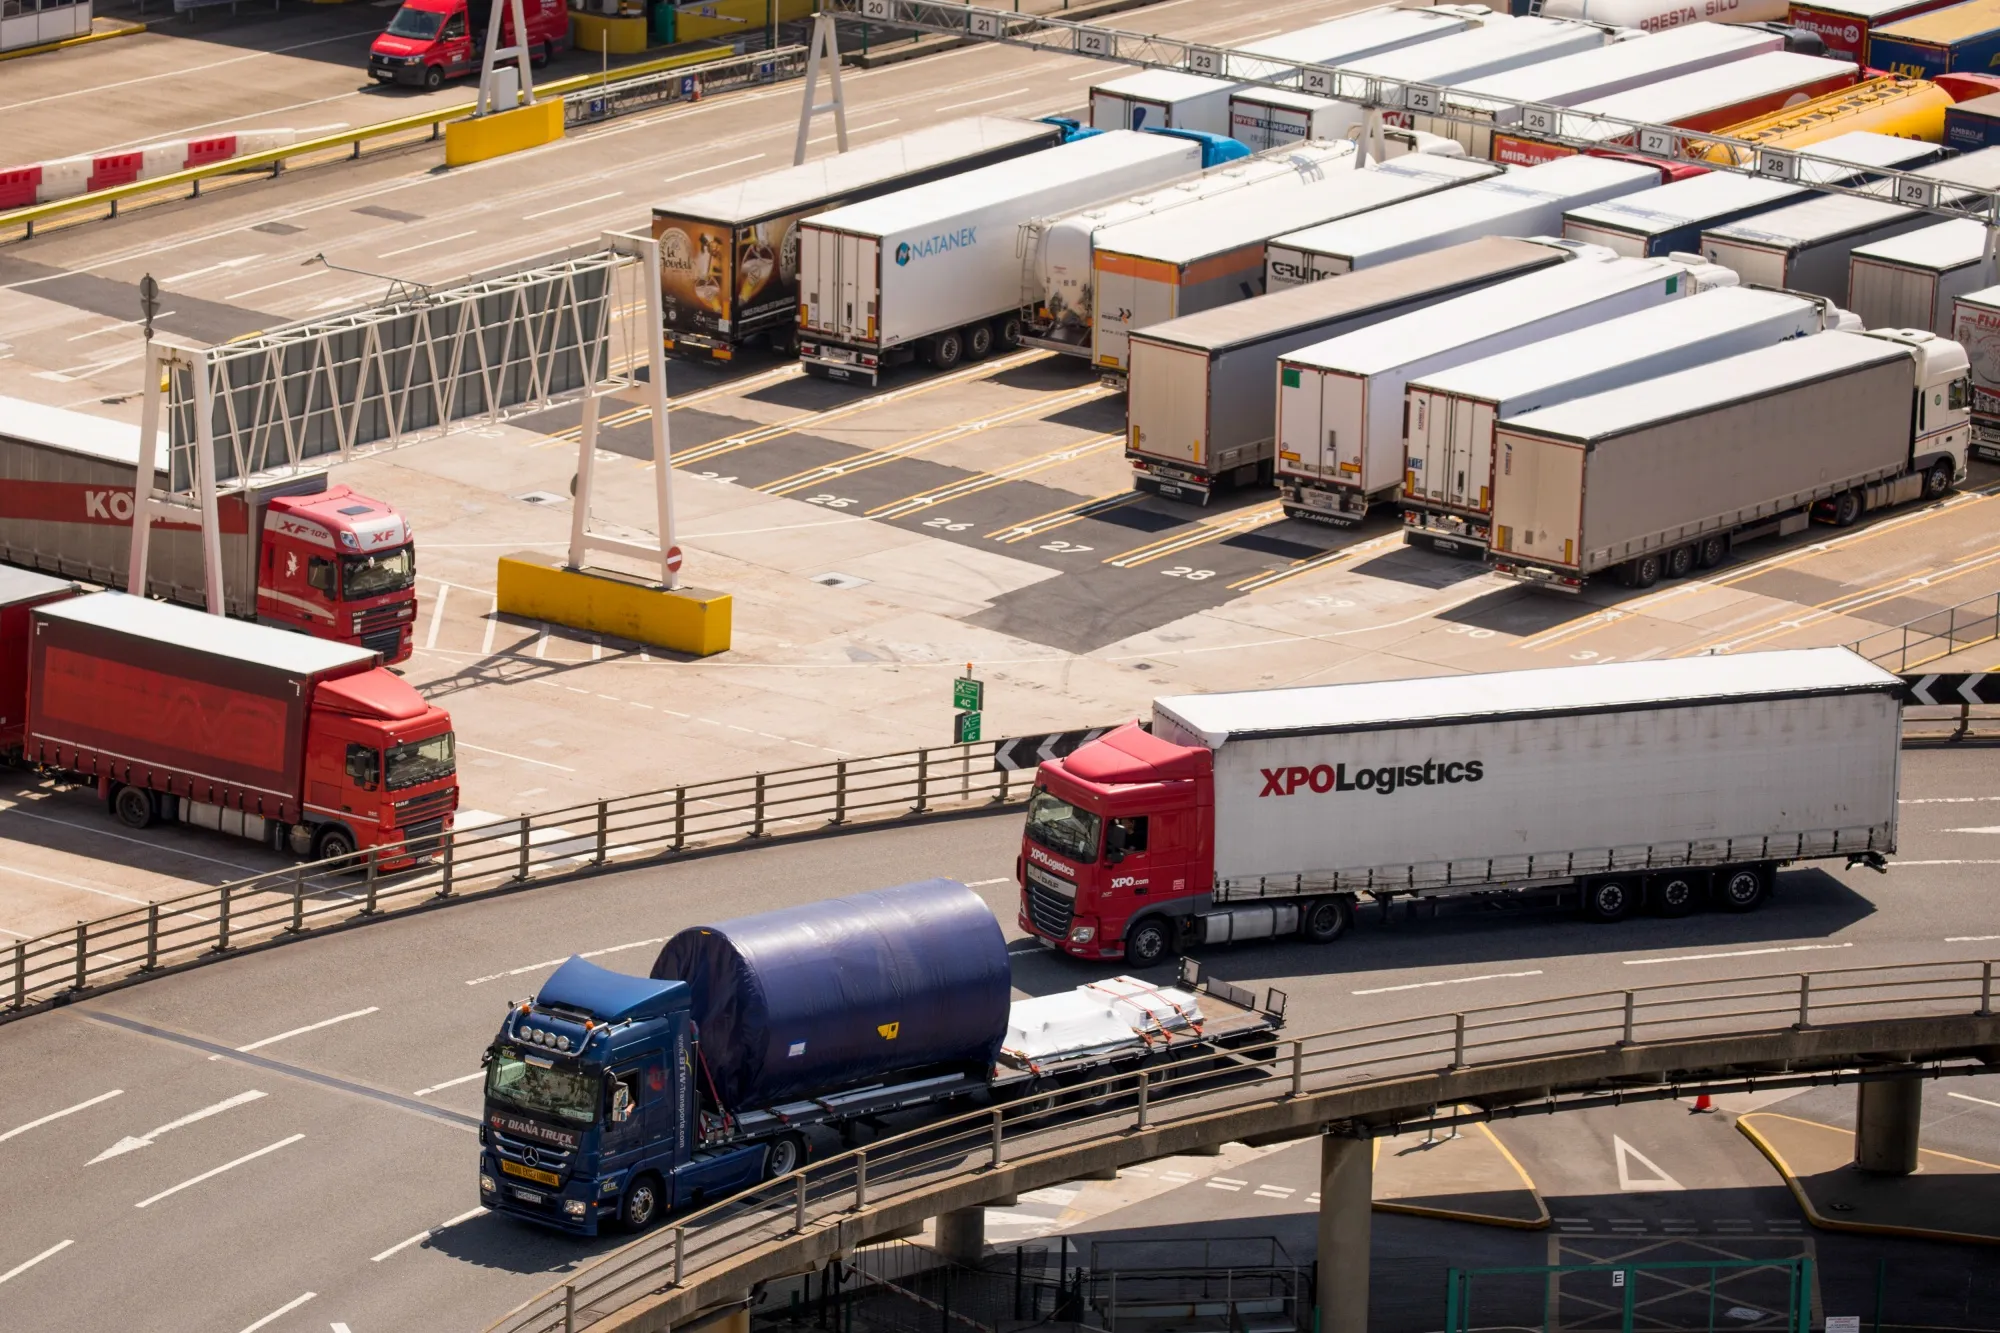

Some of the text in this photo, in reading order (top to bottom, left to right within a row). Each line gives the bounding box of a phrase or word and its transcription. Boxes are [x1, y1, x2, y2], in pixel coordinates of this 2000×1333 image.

[868, 2, 884, 14] 20
[978, 19, 991, 31] 21
[1640, 6, 1697, 31] PRESTA
[1794, 19, 1843, 37] MIRJAN
[1086, 36, 1101, 49] 22
[1196, 55, 1212, 68] 23
[684, 79, 692, 91] 2
[1309, 75, 1324, 89] 24
[1413, 94, 1429, 107] 25
[1235, 115, 1305, 135] WYSE TRANSPORT
[1529, 114, 1545, 127] 26
[1648, 136, 1663, 149] 27
[1768, 159, 1784, 172] 28
[1906, 186, 1923, 199] 29
[912, 225, 977, 261] NATANEK
[690, 471, 739, 485] 24
[805, 493, 859, 508] 25
[922, 517, 975, 531] 26
[1305, 511, 1351, 527] LAMBERET
[278, 521, 329, 540] XF 105
[371, 529, 395, 544] XF
[1039, 540, 1095, 553] 27
[1160, 566, 1217, 581] 28
[1445, 624, 1496, 639] 30
[1569, 650, 1616, 664] 31
[960, 698, 971, 708] 4C
[1259, 757, 1484, 798] XPOLogistics
[1030, 847, 1075, 877] XPOLogistics
[1041, 877, 1059, 889] DAF
[1111, 876, 1149, 889] XPO.com
[508, 1119, 539, 1136] DIANA
[540, 1128, 574, 1144] TRUCK
[1614, 1273, 1623, 1284] E
